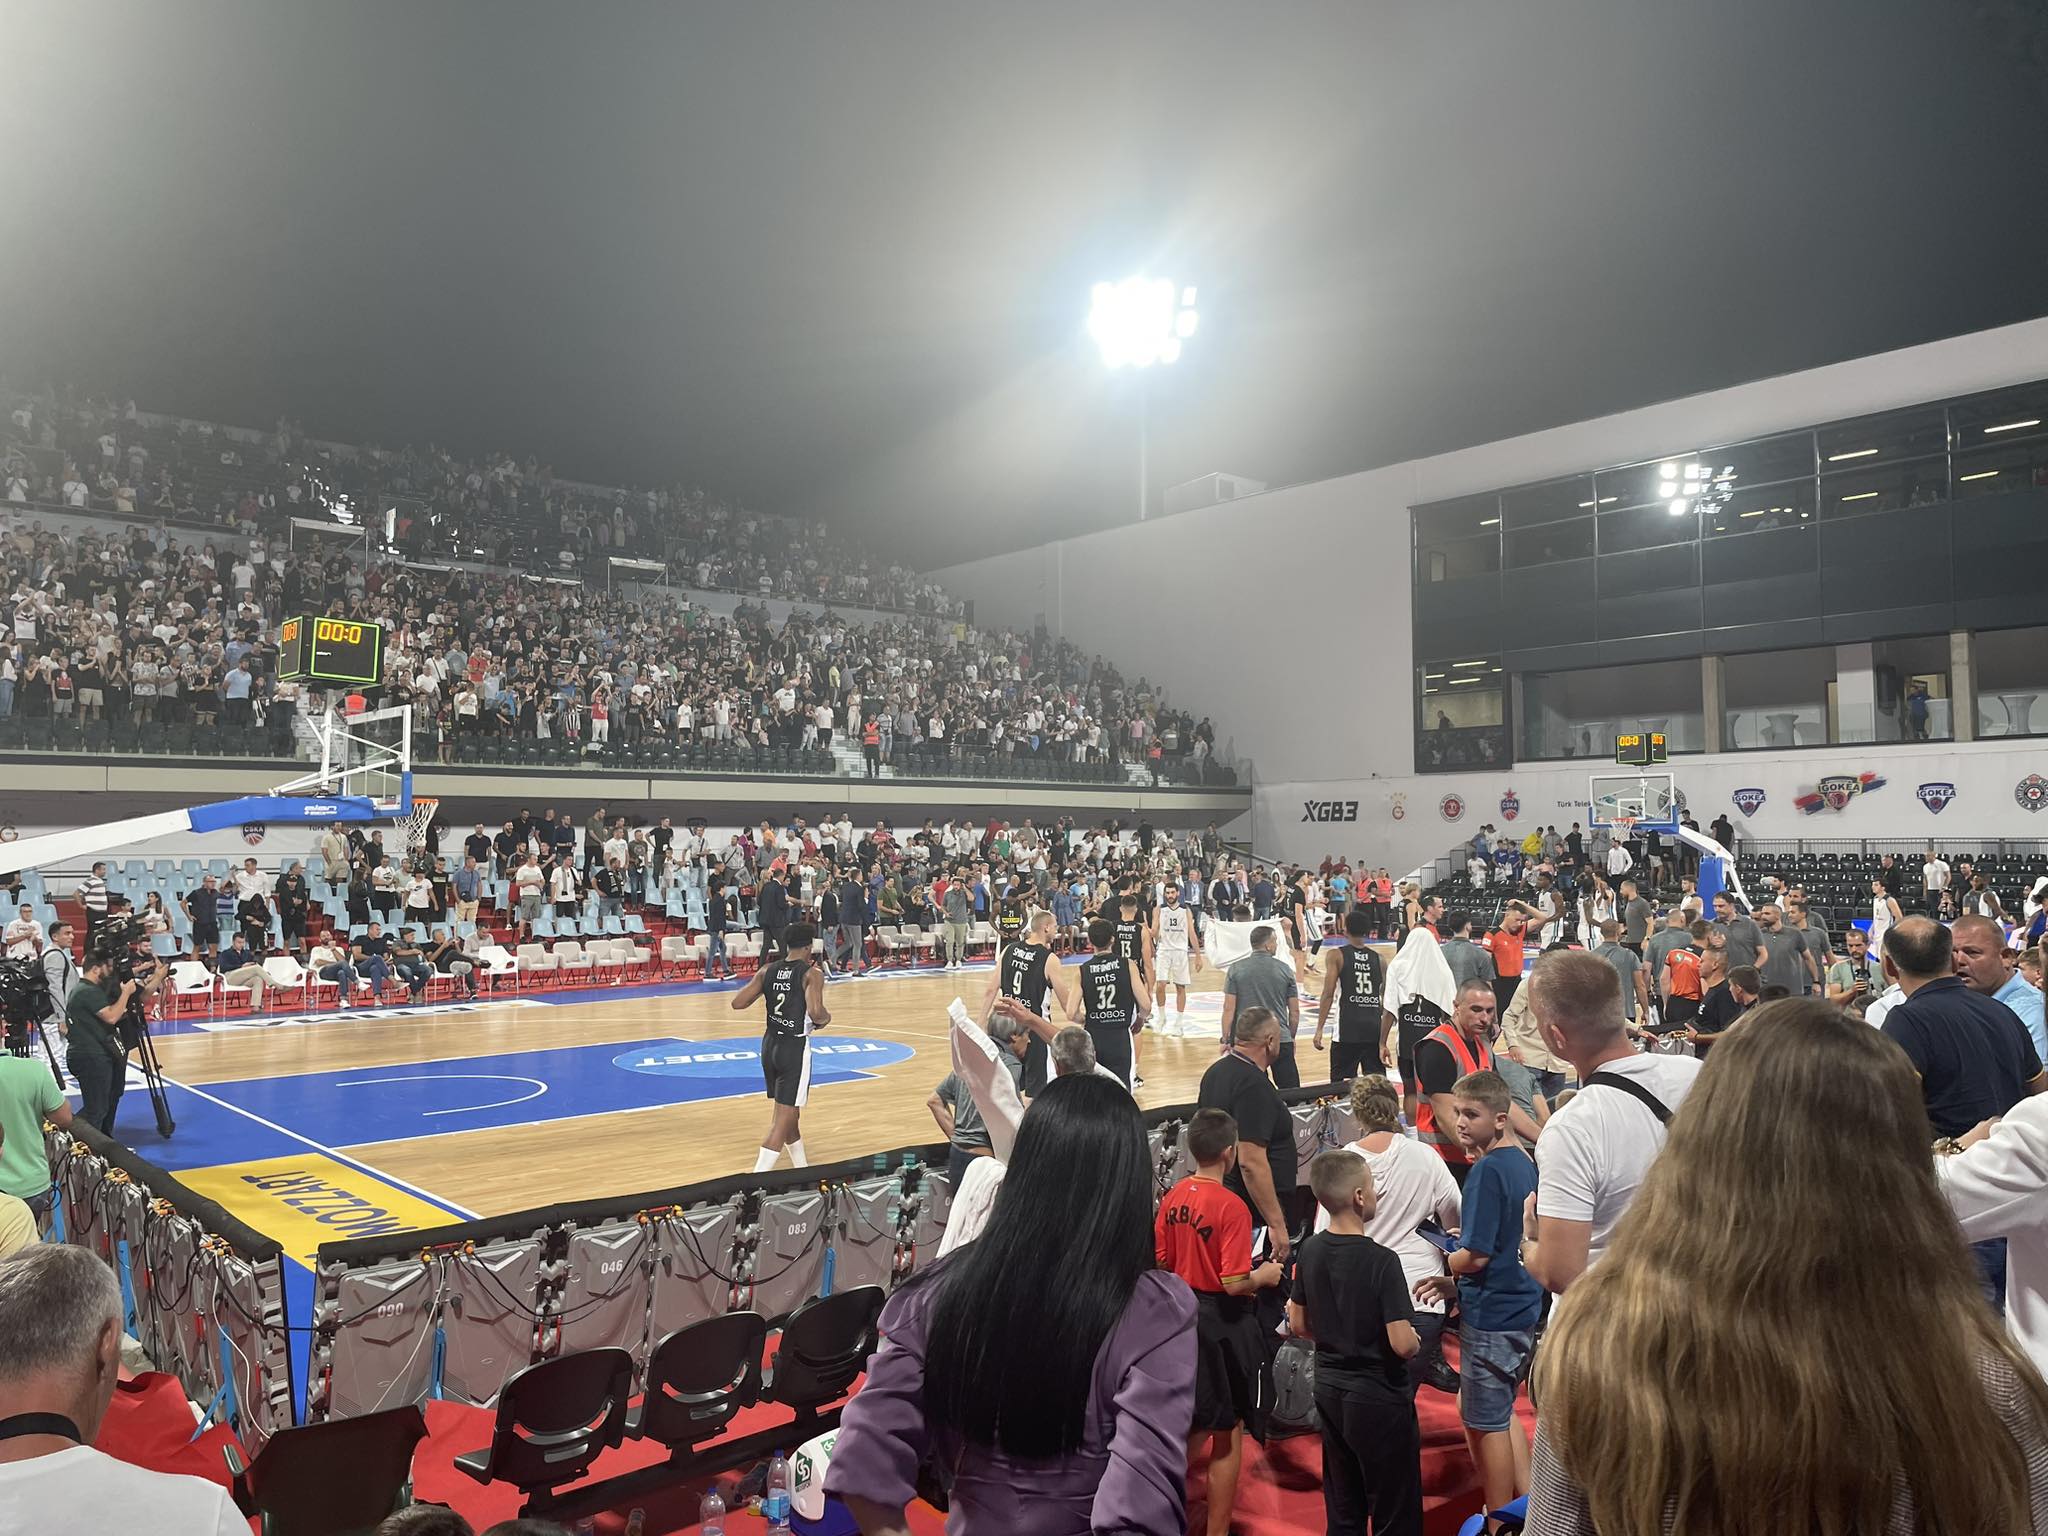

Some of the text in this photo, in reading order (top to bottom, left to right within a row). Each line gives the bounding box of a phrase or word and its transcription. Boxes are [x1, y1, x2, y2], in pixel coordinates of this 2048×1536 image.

[318, 621, 362, 645] 00:0
[1619, 735, 1640, 747] 00:0
[1818, 782, 1861, 793] IGOKEA
[1917, 788, 1956, 799] IGOKEA
[1169, 918, 1178, 927] 13
[1120, 940, 1132, 958] 13
[1011, 959, 1029, 971] mts
[1012, 970, 1023, 995] 9
[1094, 973, 1117, 984] mts
[1355, 971, 1373, 995] 35
[772, 982, 792, 991] mts
[1096, 983, 1117, 1010] 32
[1349, 995, 1379, 1004] GLOBOS
[774, 993, 786, 1016] 2
[1089, 1009, 1126, 1019] GLOBOS
[1403, 1013, 1436, 1025] GLOBOS
[240, 1170, 419, 1238] MOZZART
[787, 1222, 807, 1236] 083
[600, 1259, 623, 1275] 046
[377, 1302, 404, 1319] 090
